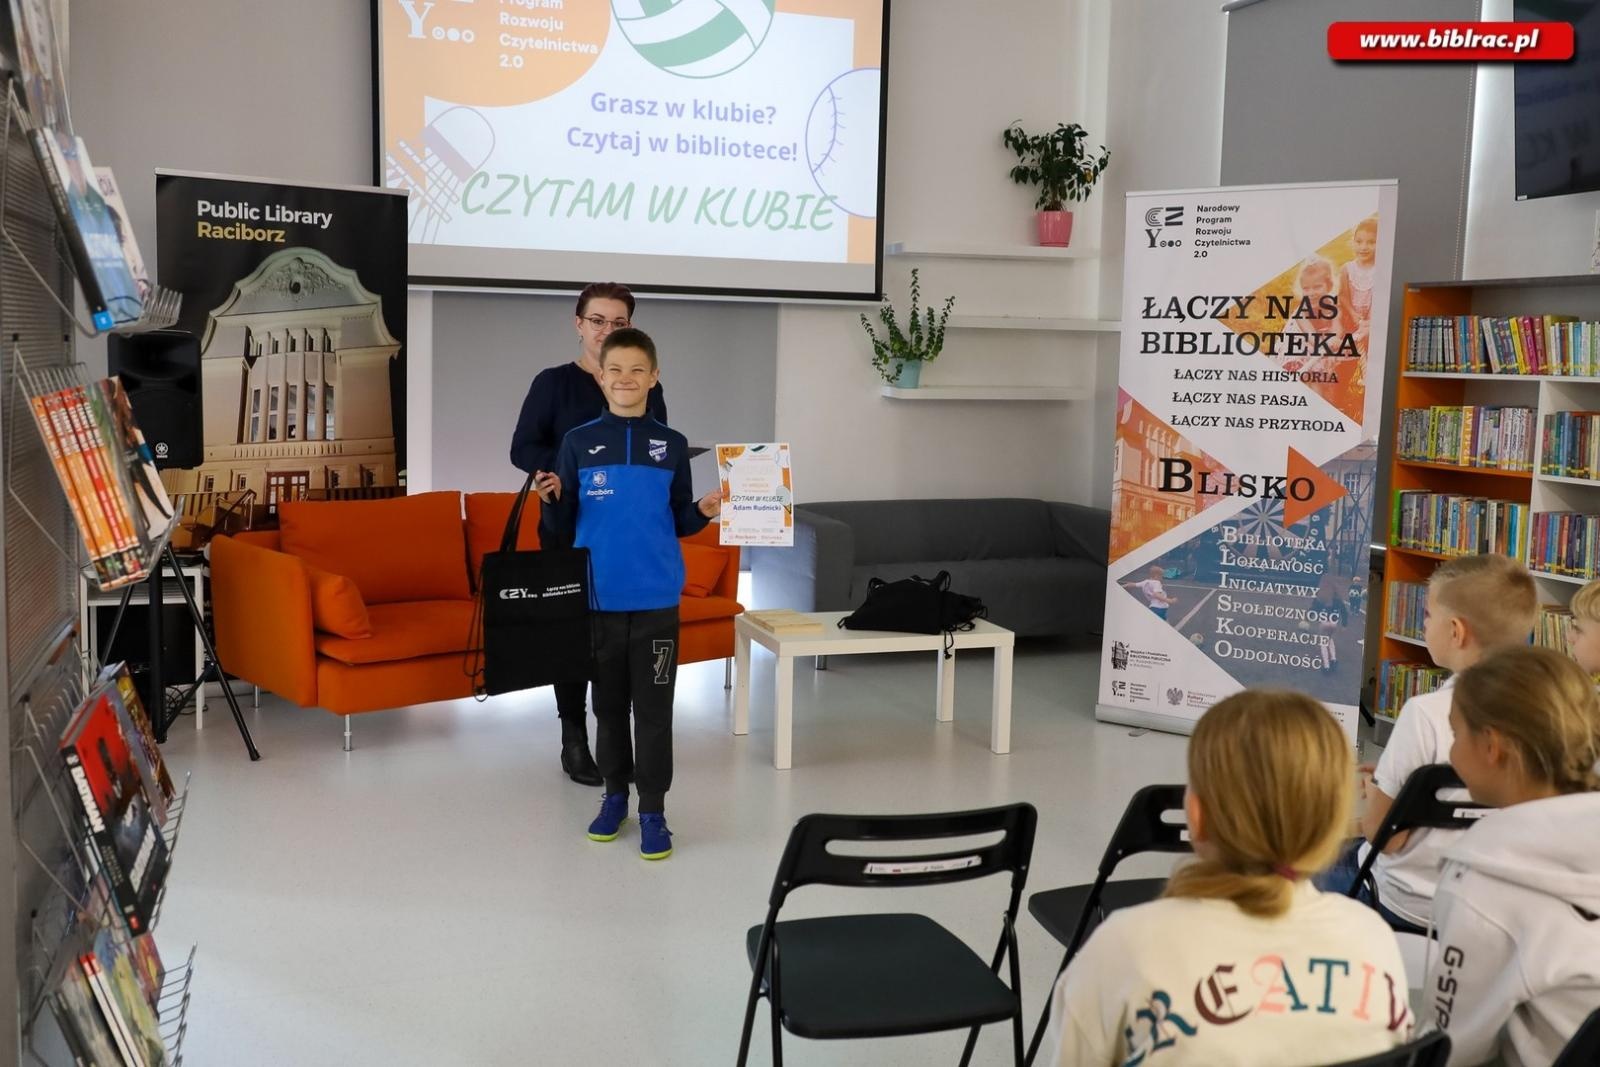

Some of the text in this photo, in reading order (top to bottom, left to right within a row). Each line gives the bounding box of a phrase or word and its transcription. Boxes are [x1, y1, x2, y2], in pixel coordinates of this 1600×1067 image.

[499, 12, 564, 31] Rozwoju
[499, 33, 598, 55] Czytelnictwa
[499, 55, 524, 68] 2.0
[590, 91, 777, 126] Grasz w klubie?
[566, 126, 798, 162] Czytaj w bibliotece!
[460, 170, 839, 231] CZYTAM W KLUBIE
[1196, 203, 1240, 214] Narodowy
[197, 200, 333, 229] Public Library
[1196, 216, 1233, 226] Program
[197, 221, 286, 243] Raciborz
[1194, 238, 1251, 248] Czytelnictwa
[1195, 227, 1232, 237] Rozwoju
[1193, 250, 1208, 259] 2.0
[1142, 295, 1339, 324] ŁĄCZY NAS
[1140, 331, 1362, 358] BIBLIOTEKA
[1174, 368, 1339, 384] ŁĄCZY NAS HISTORIA
[1172, 391, 1309, 407] ŁĄCZY NAS PASJA
[1170, 414, 1346, 433] ŁĄCZY NAS PRZYRODA
[753, 504, 782, 512] Rudnicki
[1222, 525, 1327, 552] BIBLIOTEKA
[1220, 549, 1324, 575] LOKALNOŚĆ
[1218, 571, 1320, 598] INICJATYWY
[1215, 616, 1330, 647] KOOPERACJE
[652, 639, 675, 684] 7
[1214, 639, 1323, 670] ODDOLNOŚĆ
[71, 765, 105, 832] BATMAN
